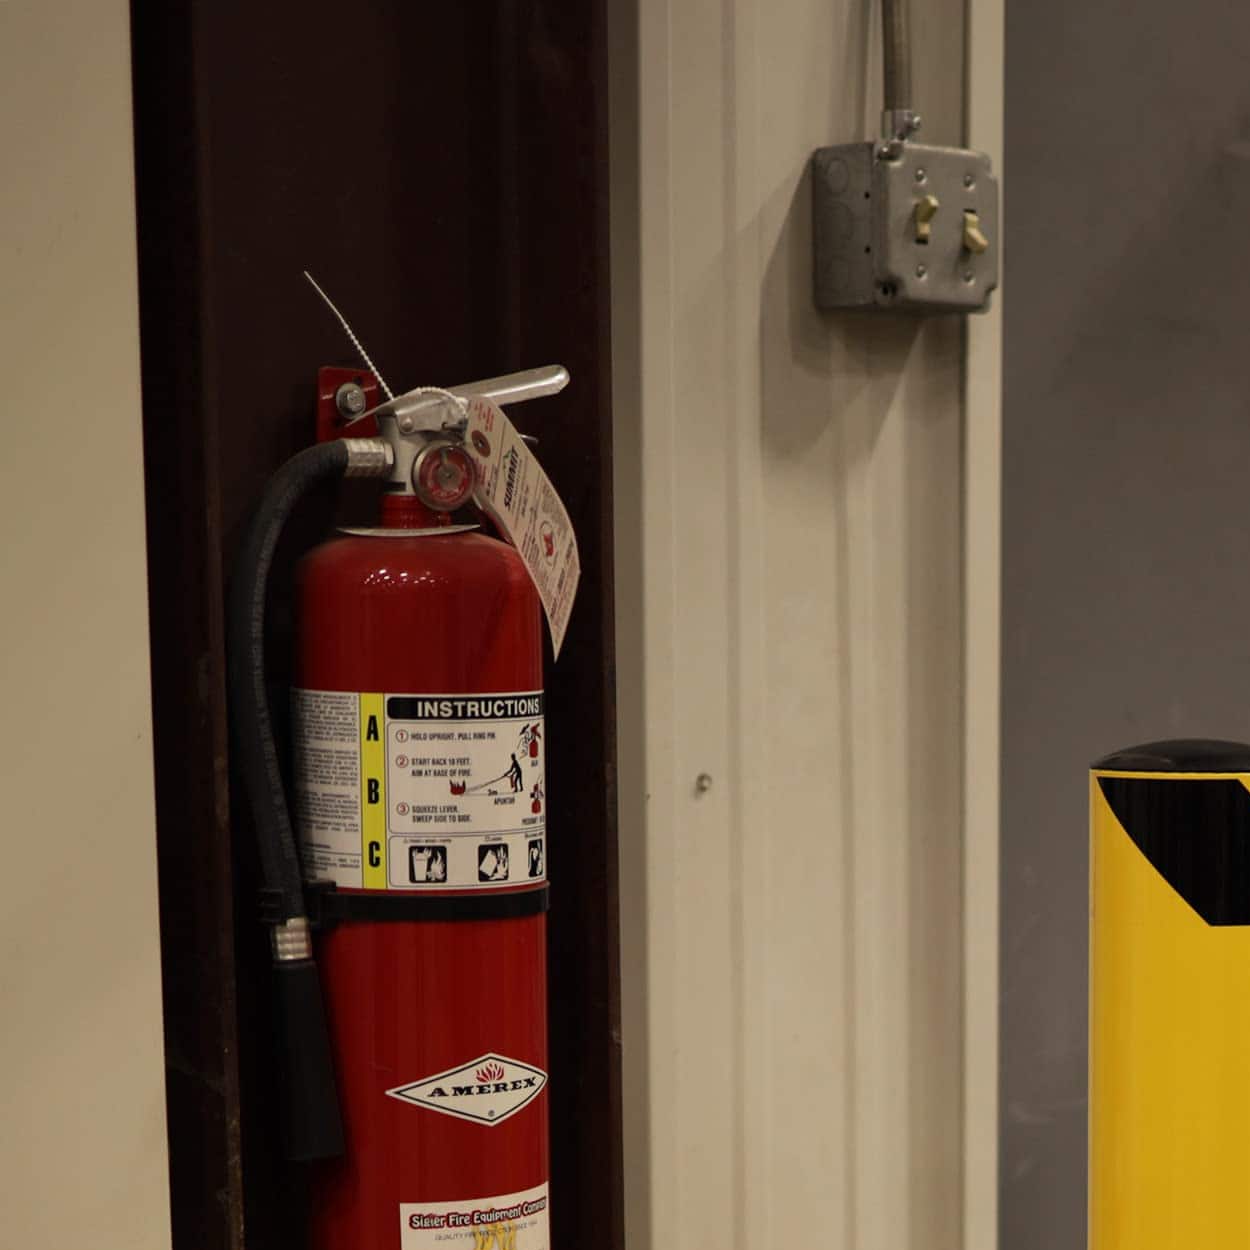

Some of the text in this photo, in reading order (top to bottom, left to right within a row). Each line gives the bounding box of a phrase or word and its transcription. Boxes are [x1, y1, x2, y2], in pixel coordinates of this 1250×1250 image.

[503, 446, 519, 508] SUMMIT
[417, 698, 540, 718] INSTRUCTIONS
[366, 714, 379, 742] A
[411, 732, 427, 741] HOLD
[457, 732, 472, 740] PULL
[411, 757, 431, 766] START
[432, 757, 447, 766] BACK
[411, 769, 423, 777] AIM
[424, 769, 432, 777] AT
[433, 769, 448, 777] BASE
[449, 769, 458, 777] OF
[367, 777, 381, 805] B
[411, 805, 438, 814] SQUEEZE
[412, 815, 433, 823] SWEEP
[434, 815, 448, 823] SIDE
[448, 815, 457, 823] TO
[369, 841, 381, 868] C
[427, 1076, 537, 1097] AMEREX
[448, 1212, 471, 1226] Fire
[473, 1204, 522, 1224] Equipment
